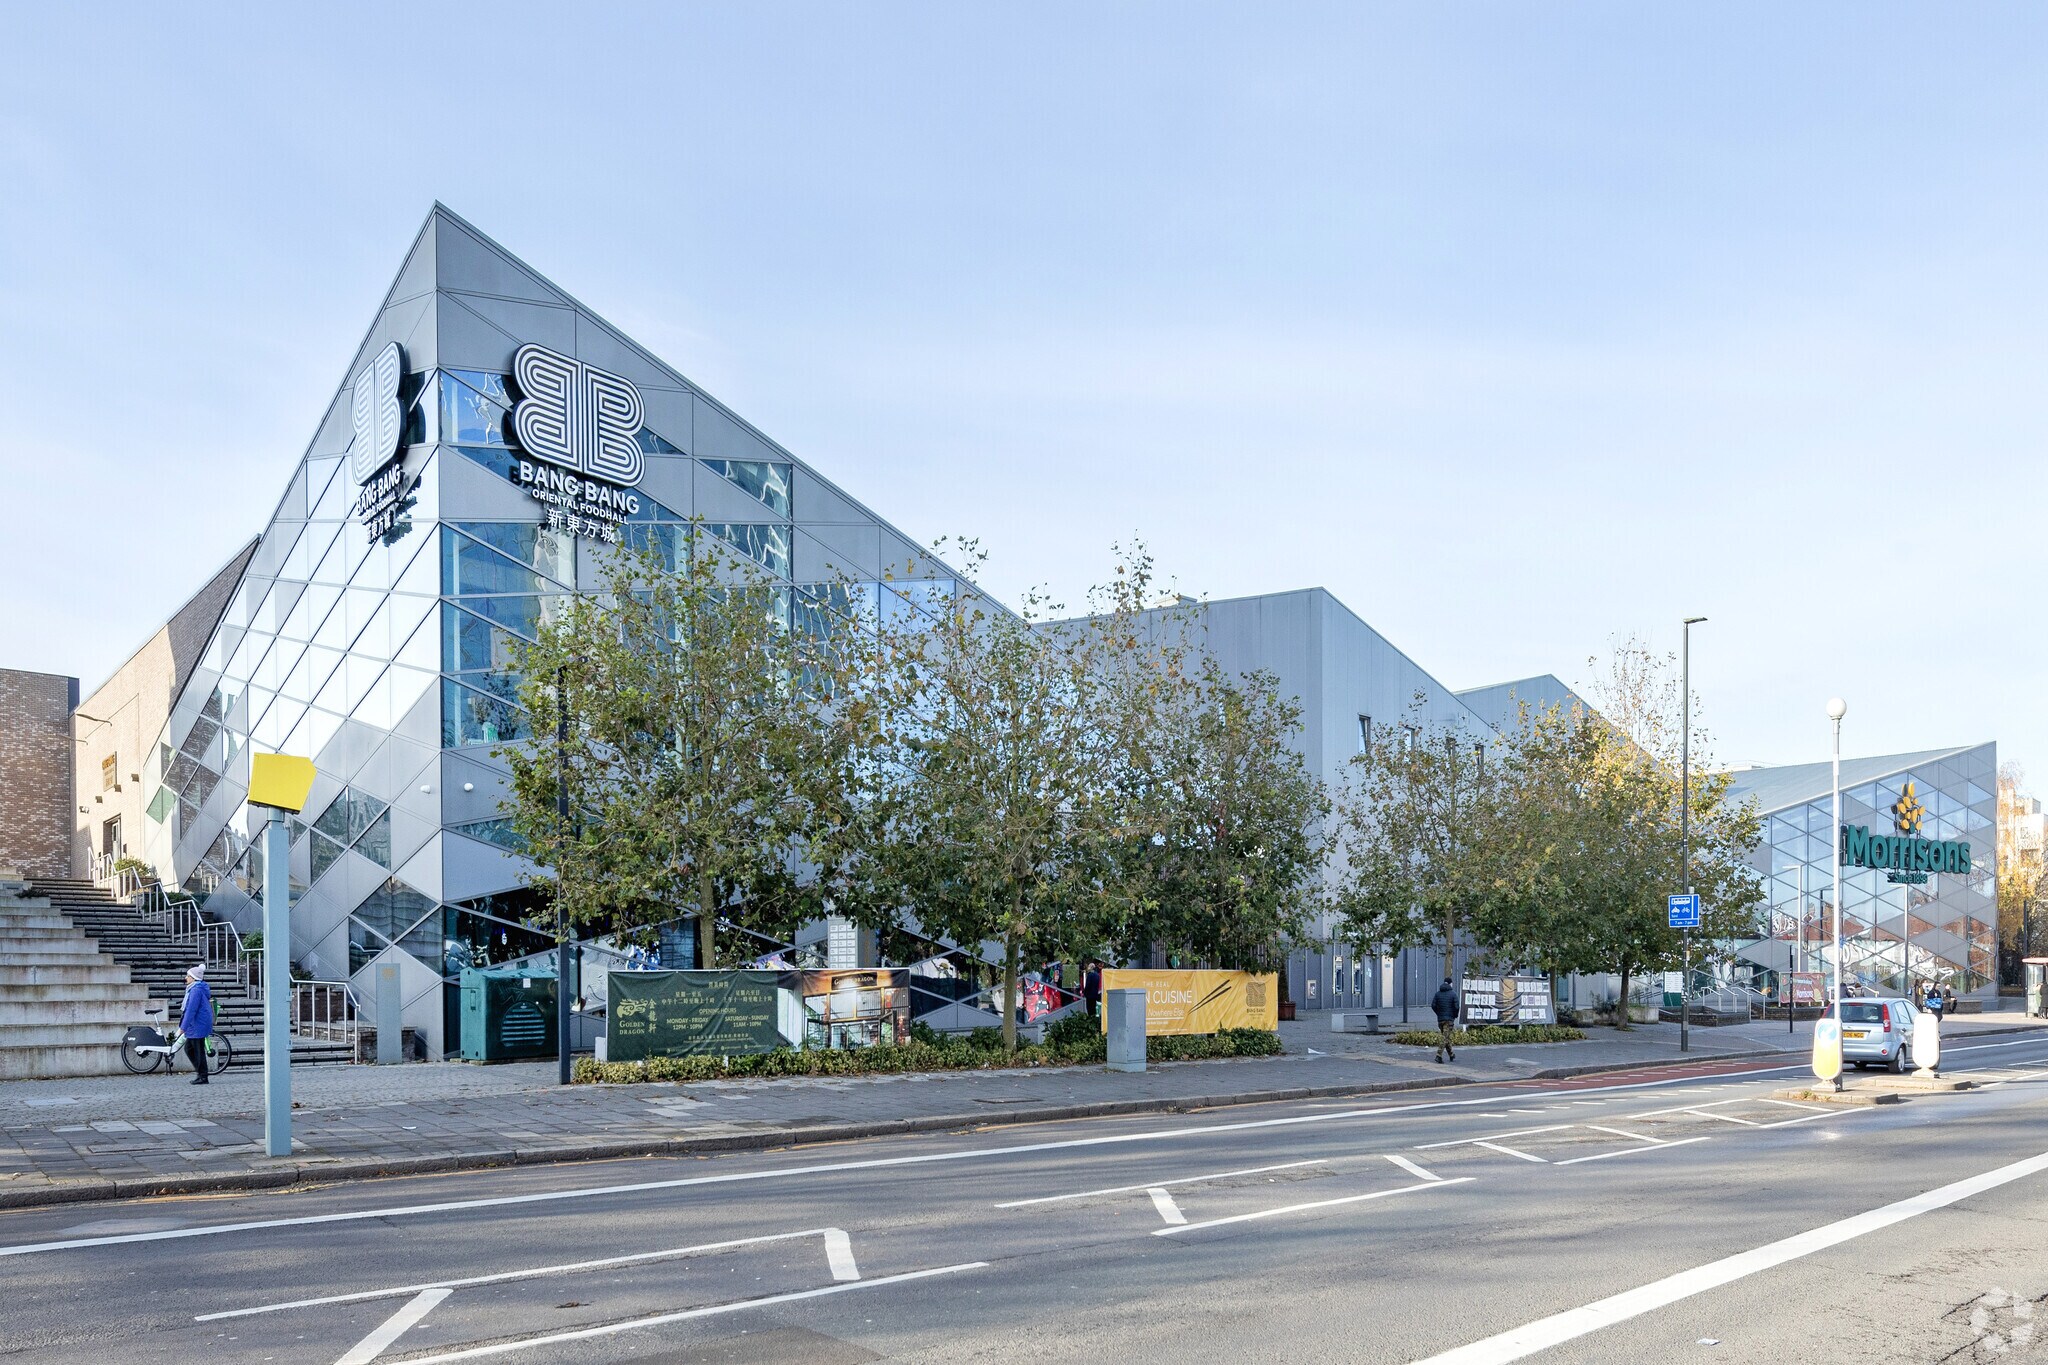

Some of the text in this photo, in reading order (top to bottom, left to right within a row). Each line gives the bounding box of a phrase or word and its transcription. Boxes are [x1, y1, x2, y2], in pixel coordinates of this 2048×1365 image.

[356, 463, 400, 512] BANG BANG
[520, 460, 640, 514] BANG BANG
[532, 489, 629, 525] ORIENTAL FOODHALL
[547, 508, 616, 543] 新東方城
[1847, 825, 1971, 874] Morrisons
[1894, 872, 1913, 883] Since
[1153, 990, 1193, 1004] CUISINE
